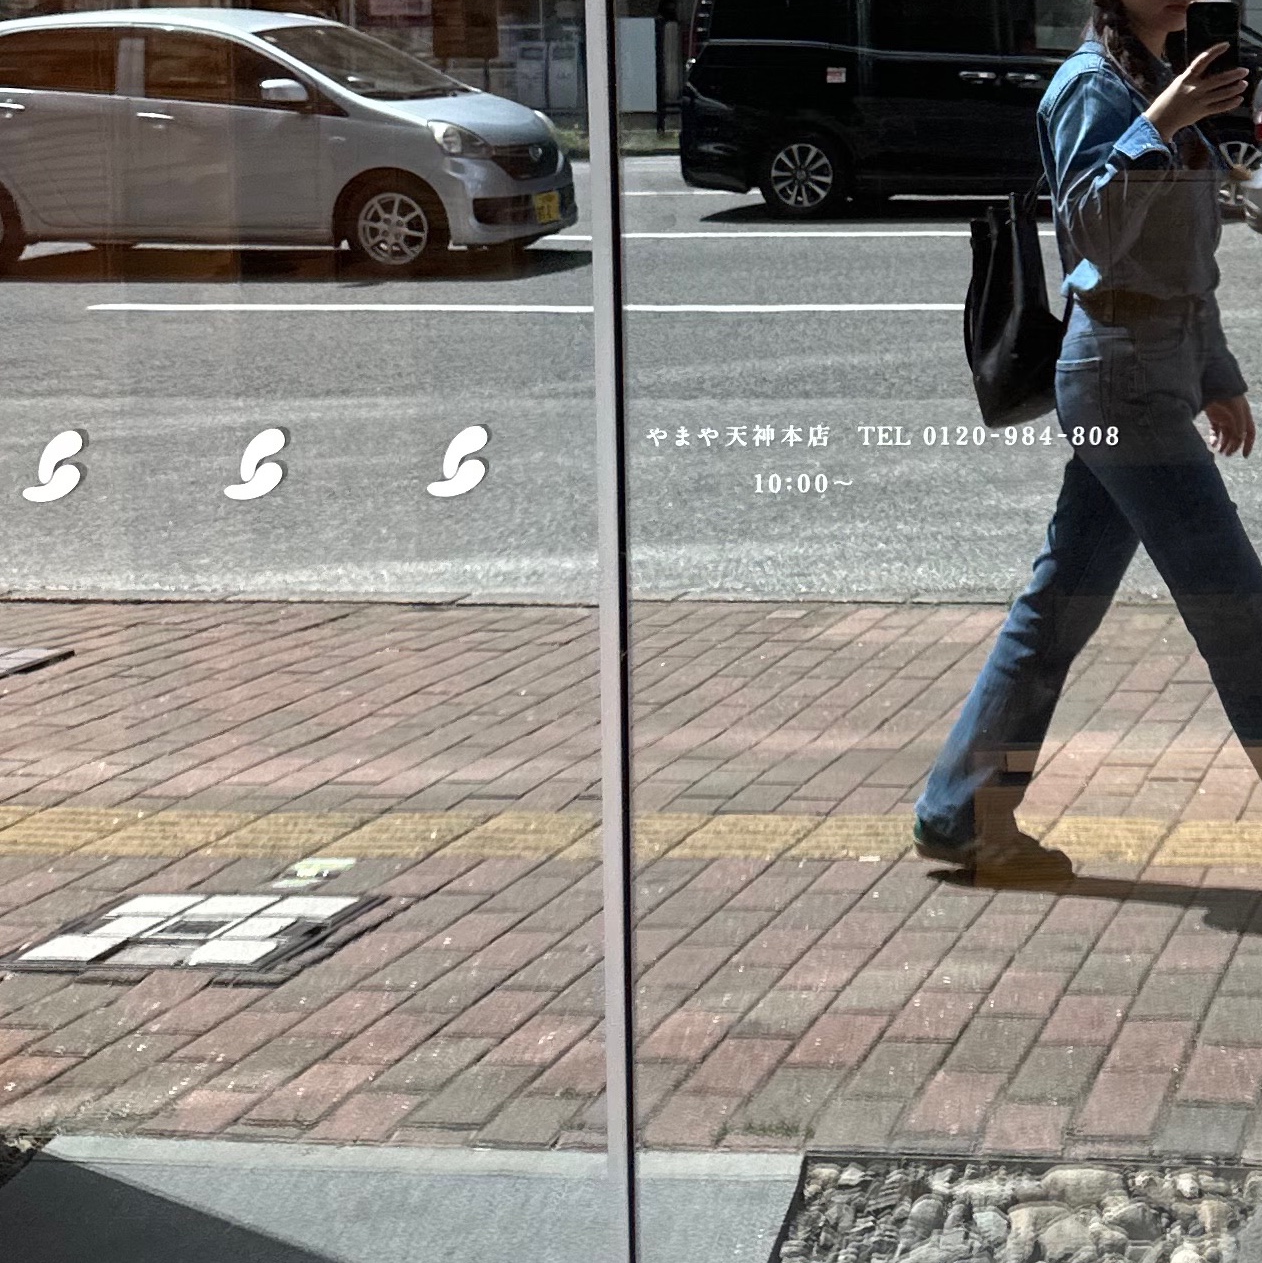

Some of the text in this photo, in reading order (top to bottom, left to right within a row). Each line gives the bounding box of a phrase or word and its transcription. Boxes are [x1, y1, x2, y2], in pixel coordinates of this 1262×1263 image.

[645, 424, 1121, 448] やまや天神本店 TEL 0120-984-808
